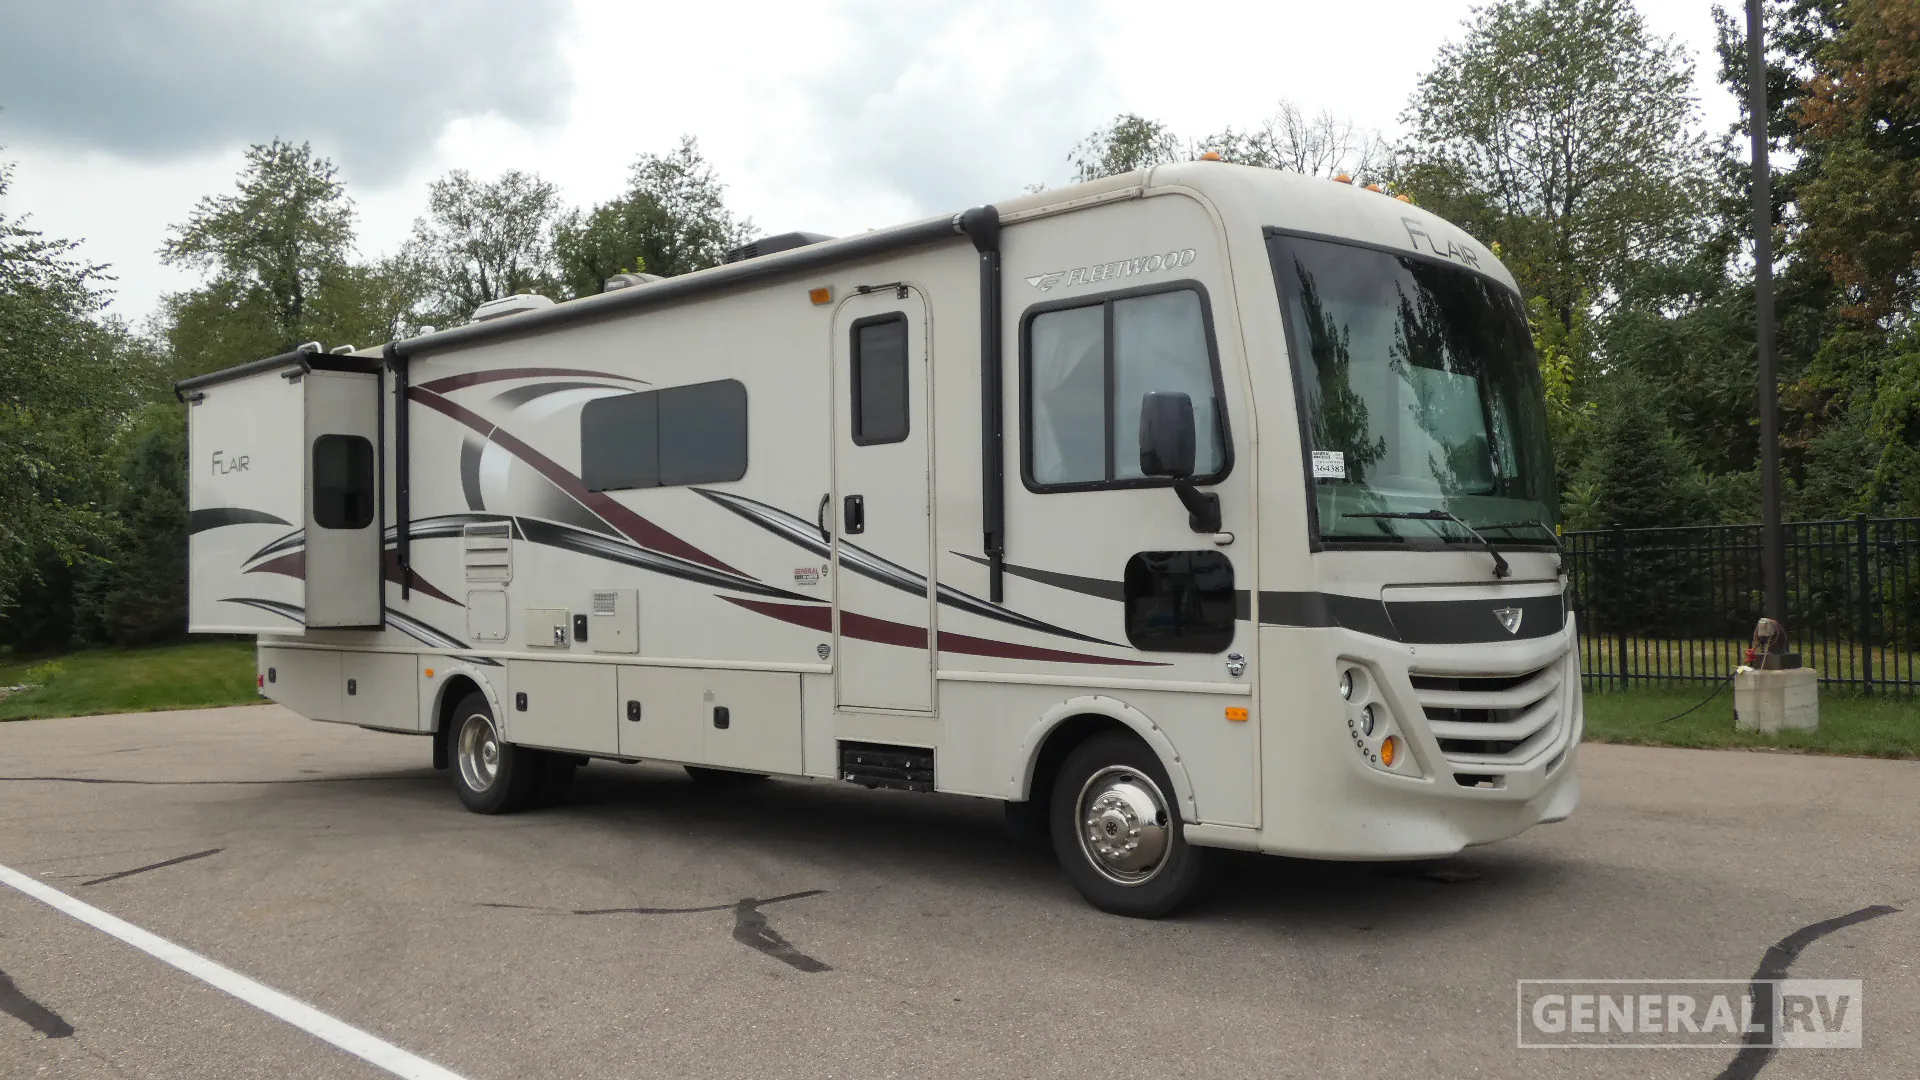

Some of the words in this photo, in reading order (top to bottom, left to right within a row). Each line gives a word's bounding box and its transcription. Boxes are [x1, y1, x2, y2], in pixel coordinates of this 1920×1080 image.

[1401, 217, 1481, 270] FLAIR
[1066, 248, 1196, 287] FLEETWOOD
[212, 450, 250, 476] FLAIR
